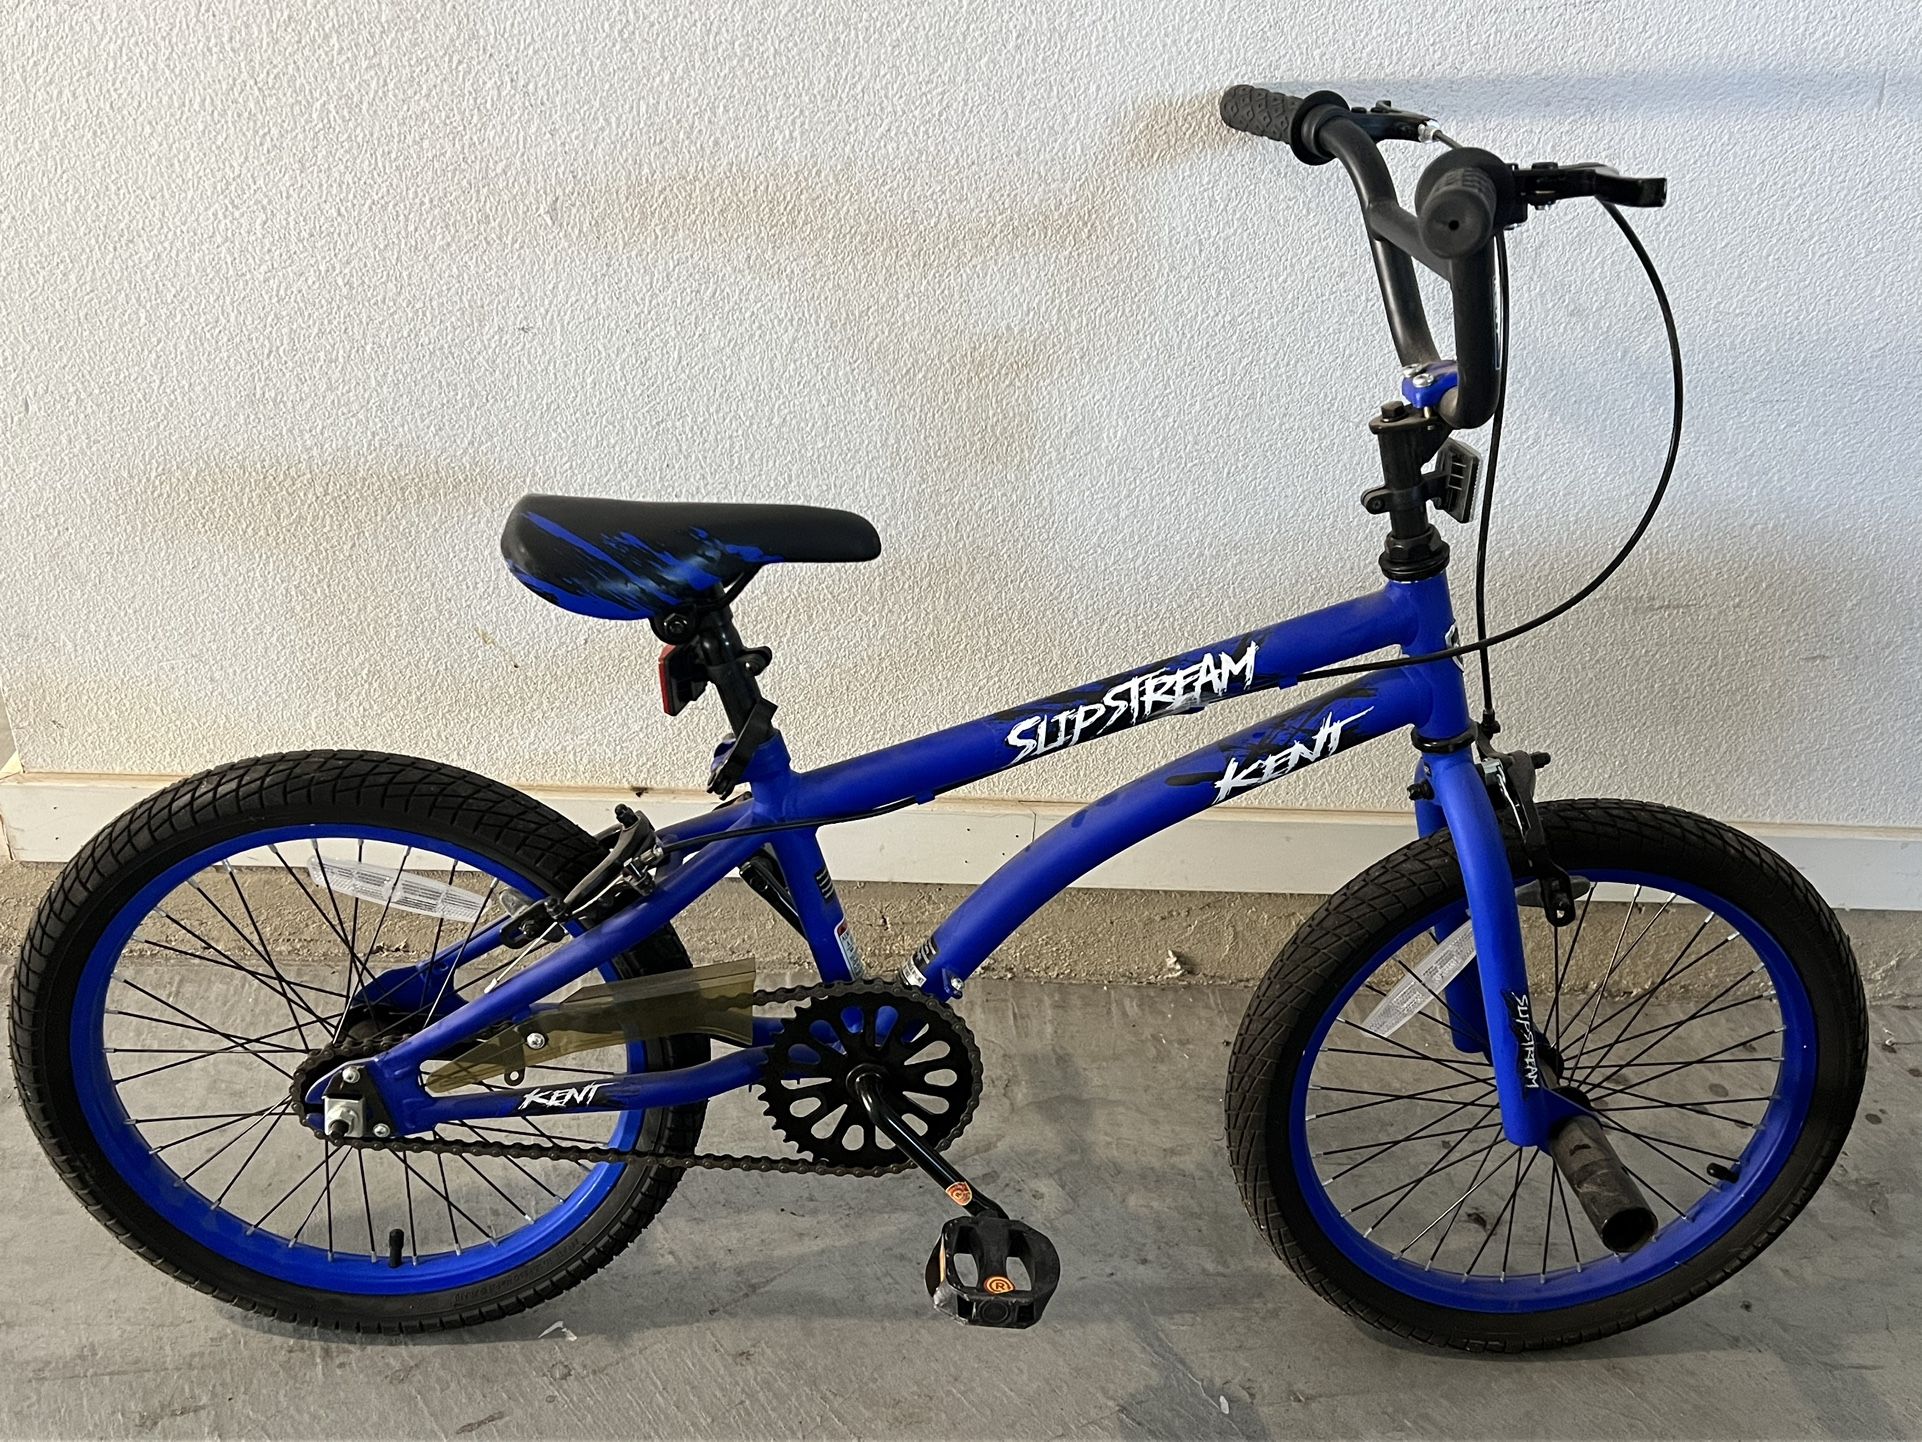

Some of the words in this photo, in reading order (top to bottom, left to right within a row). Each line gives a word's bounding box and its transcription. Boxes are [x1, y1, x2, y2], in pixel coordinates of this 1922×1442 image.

[1005, 640, 1260, 765] SLIPSTREAM
[1214, 706, 1374, 804] KENT
[518, 1081, 618, 1110] KENT
